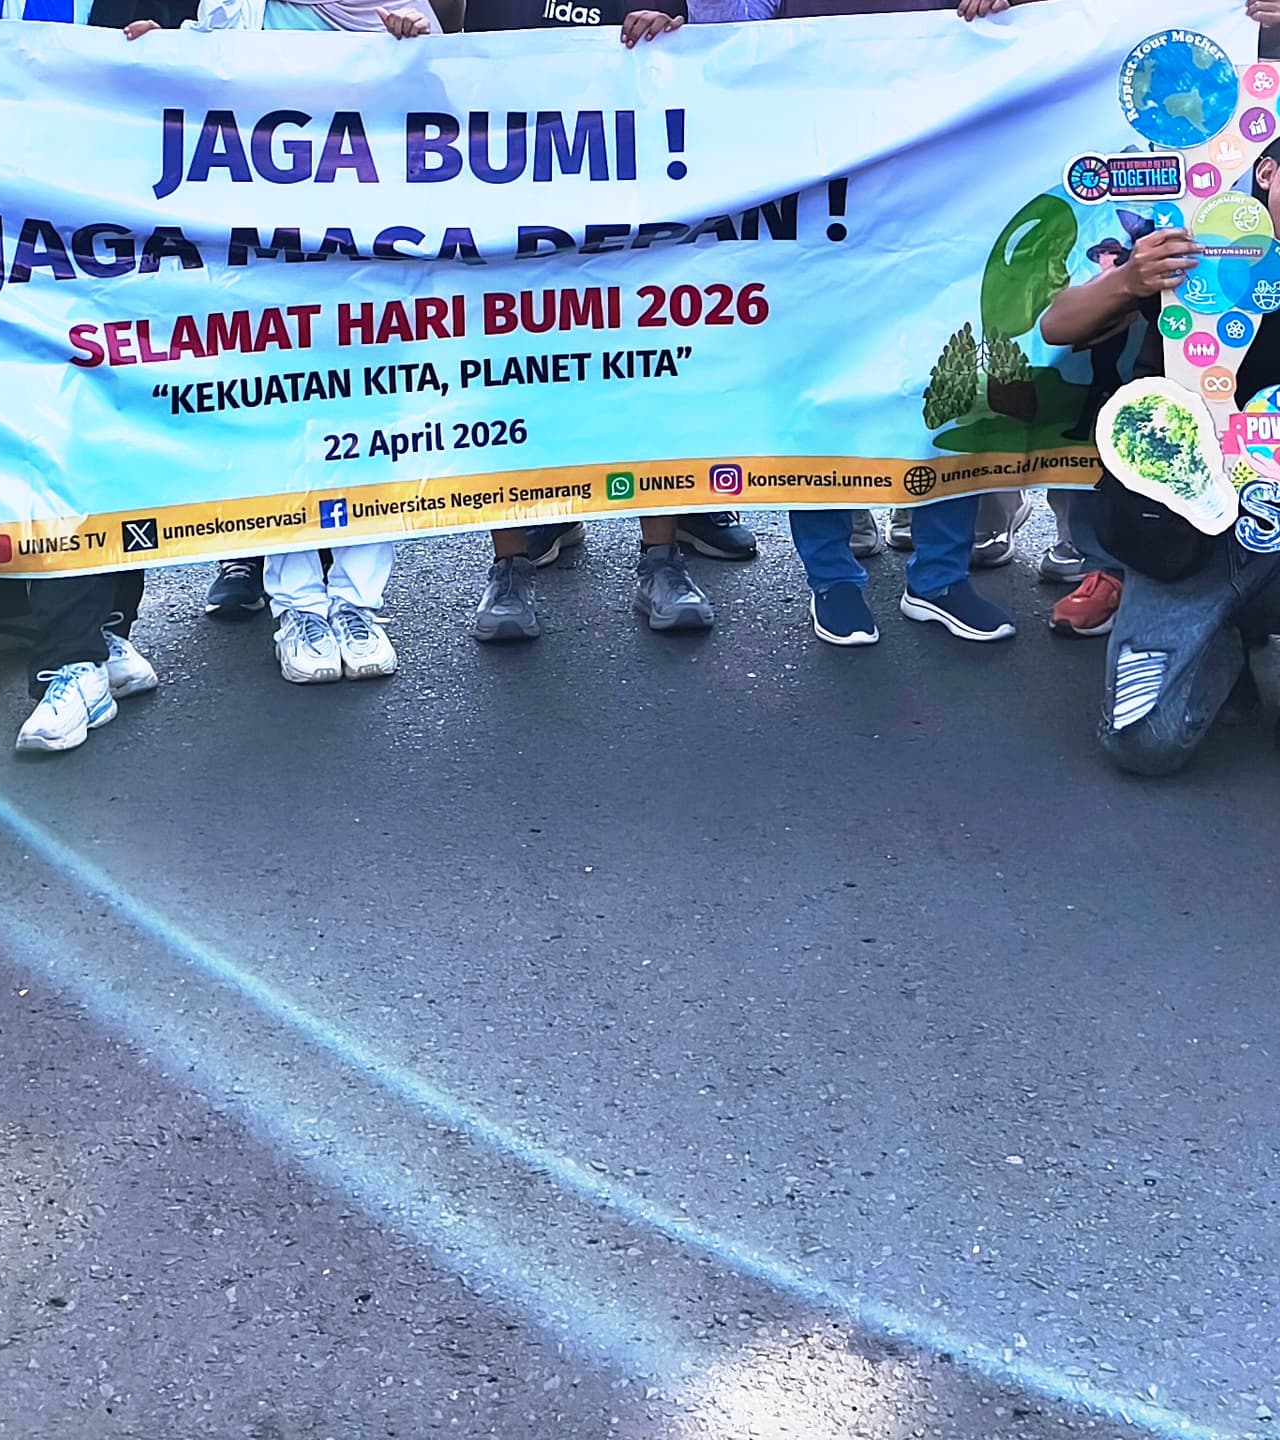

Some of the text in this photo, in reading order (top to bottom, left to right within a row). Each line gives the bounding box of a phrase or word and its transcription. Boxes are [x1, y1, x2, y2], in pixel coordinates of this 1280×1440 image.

[1123, 31, 1225, 122] Respect Your Mother
[152, 108, 379, 200] JAGA
[406, 110, 637, 184] BUMI
[1110, 168, 1178, 187] TOGETHER
[69, 282, 769, 369] SELAMAT HARI BUMI 2026
[363, 362, 449, 397] KITA,
[460, 352, 592, 388] PLANET
[323, 418, 528, 462] 22 April 2026
[639, 475, 695, 492] UNNES
[748, 469, 892, 489] konservasi.unnes
[352, 481, 592, 519] Universitas Negeri Semarang
[163, 508, 307, 540] unneskonservasi
[18, 532, 107, 556] UNNES TV
